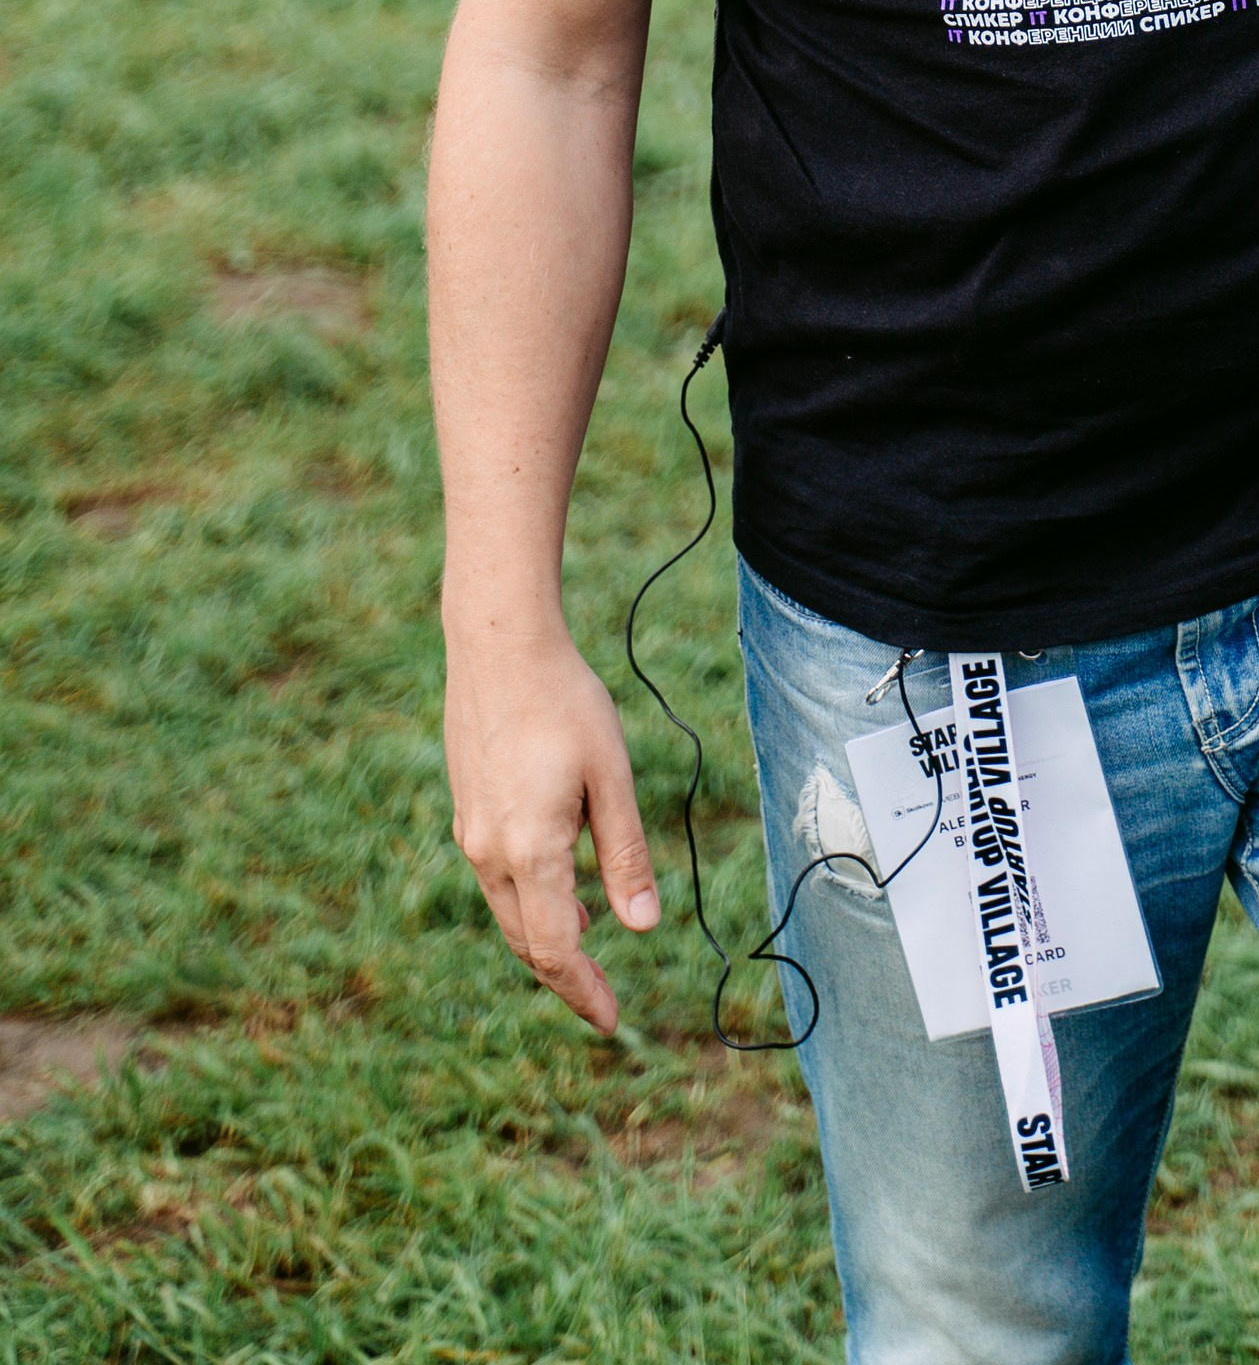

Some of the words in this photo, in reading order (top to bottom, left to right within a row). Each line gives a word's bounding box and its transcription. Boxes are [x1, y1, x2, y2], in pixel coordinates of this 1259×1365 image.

[943, 11, 1023, 28] СПИКЕР
[1029, 10, 1048, 26] IT
[947, 29, 963, 44] IT
[968, 19, 1135, 46] КОНФЕРЕНЦИИ
[1139, 1, 1225, 32] СПИКЕР
[962, 659, 1012, 787] VILLAGE
[978, 871, 1028, 1009] VILLAGE
[1024, 946, 1066, 966] CARD
[1037, 978, 1073, 998] KER
[1017, 1113, 1065, 1190] STAR
